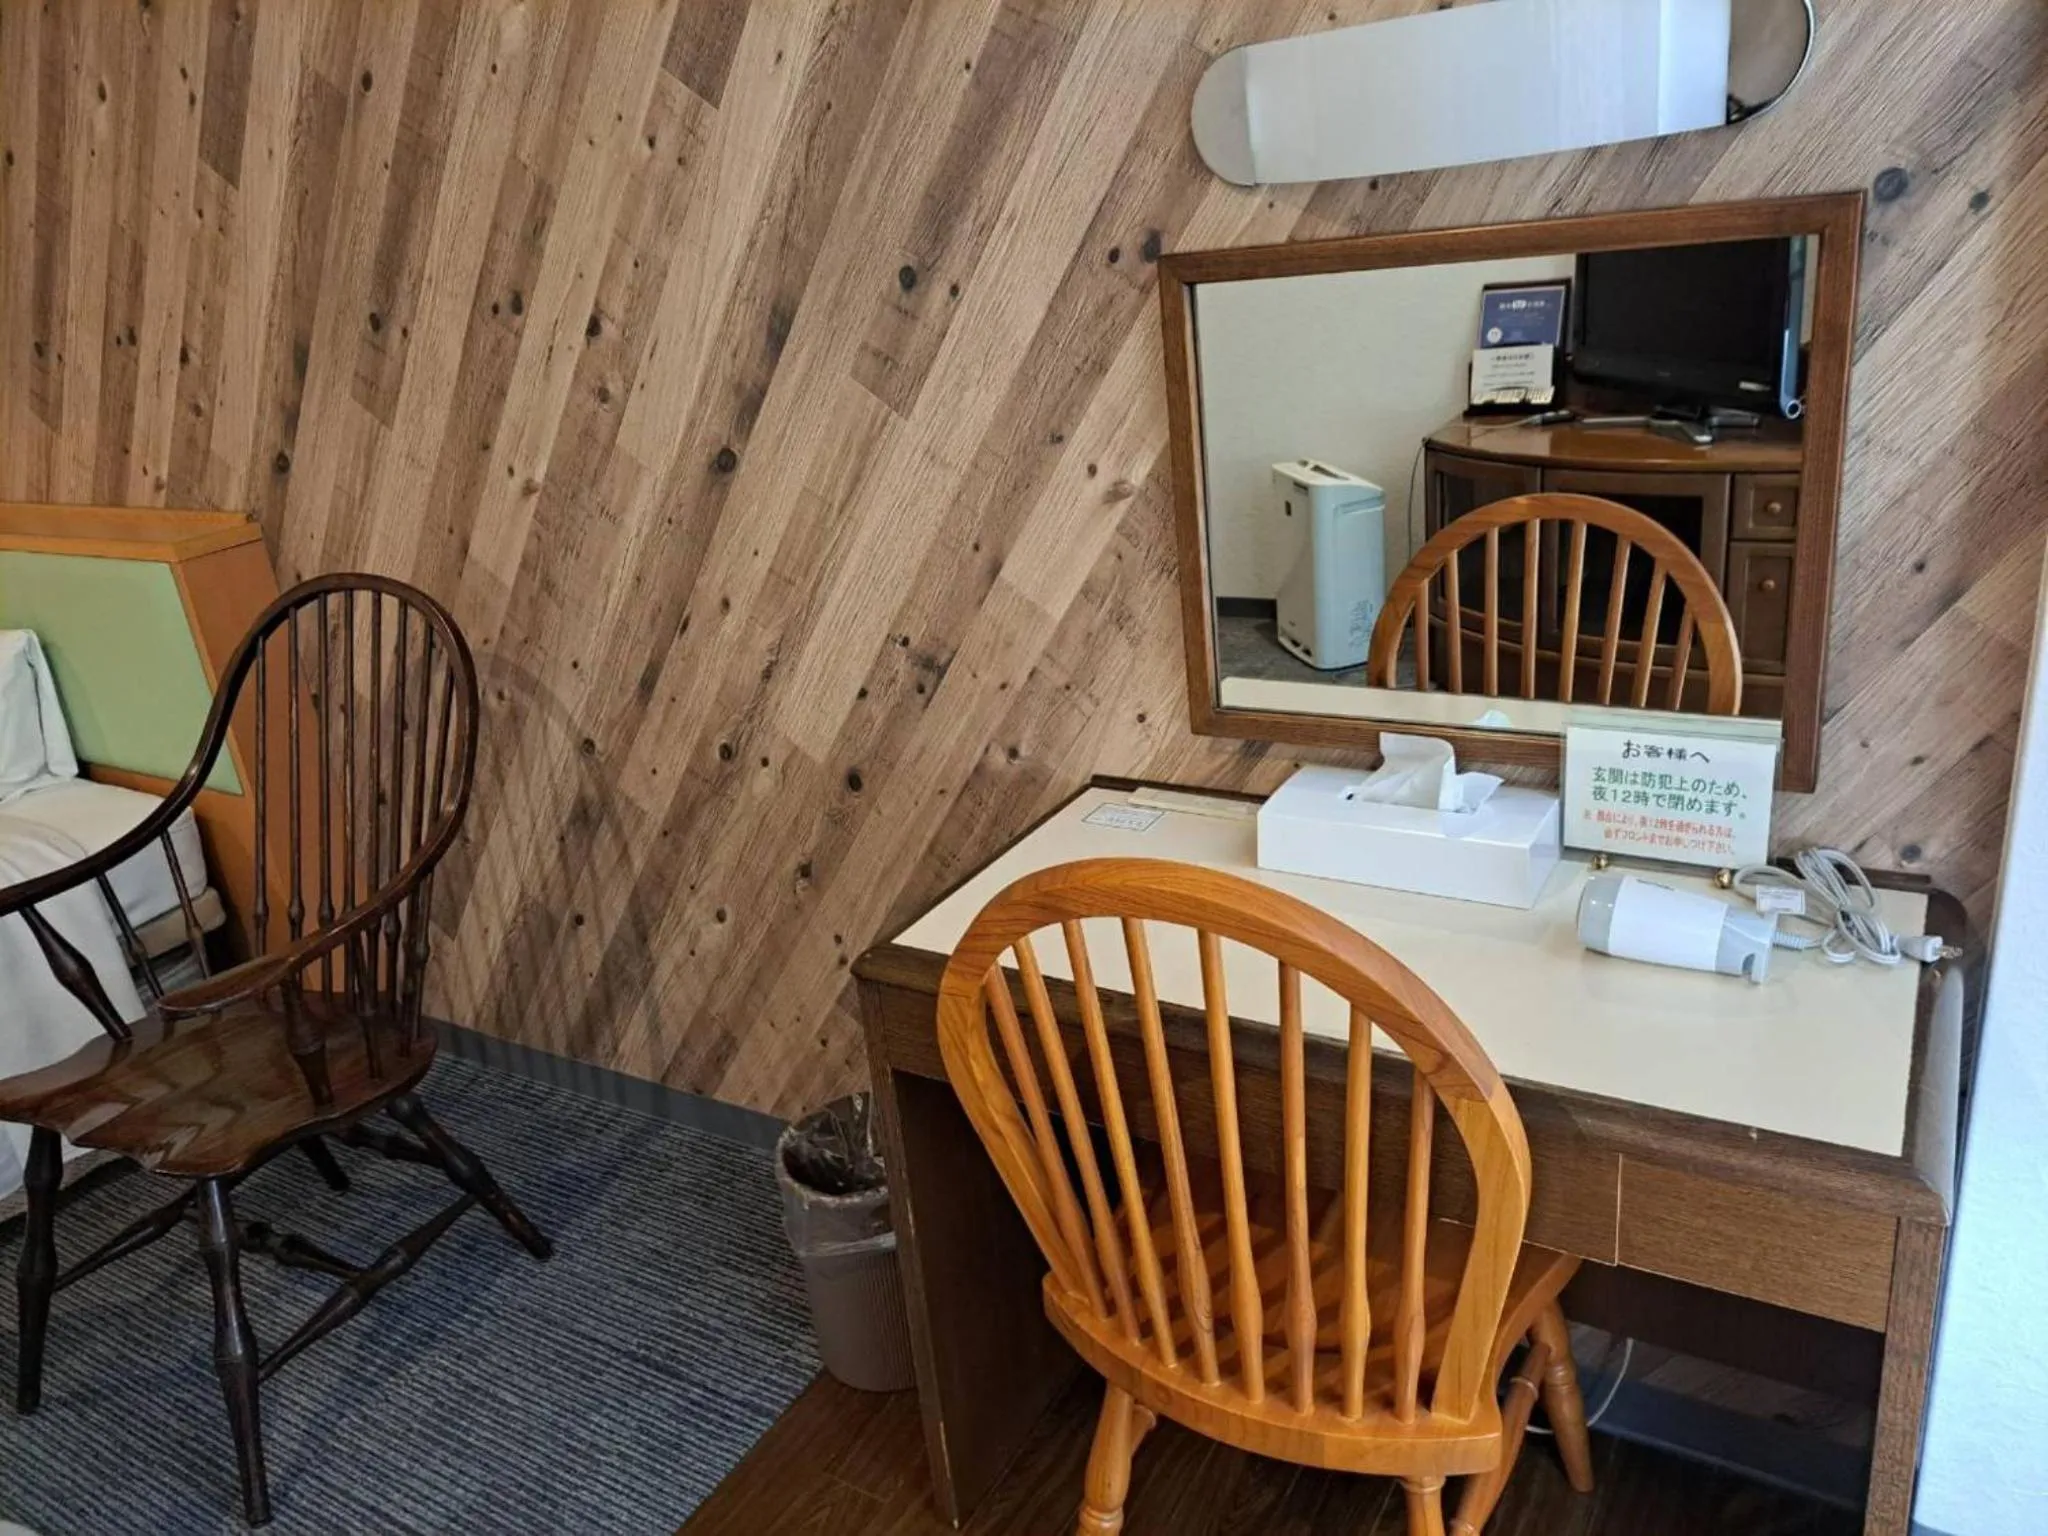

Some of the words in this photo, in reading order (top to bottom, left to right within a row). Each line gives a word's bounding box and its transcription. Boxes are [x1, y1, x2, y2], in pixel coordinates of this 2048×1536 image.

[1621, 739, 1710, 763] お客様へ
[1592, 766, 1748, 799] 玄関は防犯上のため、
[1591, 785, 1747, 820] 夜12時で閉めます。
